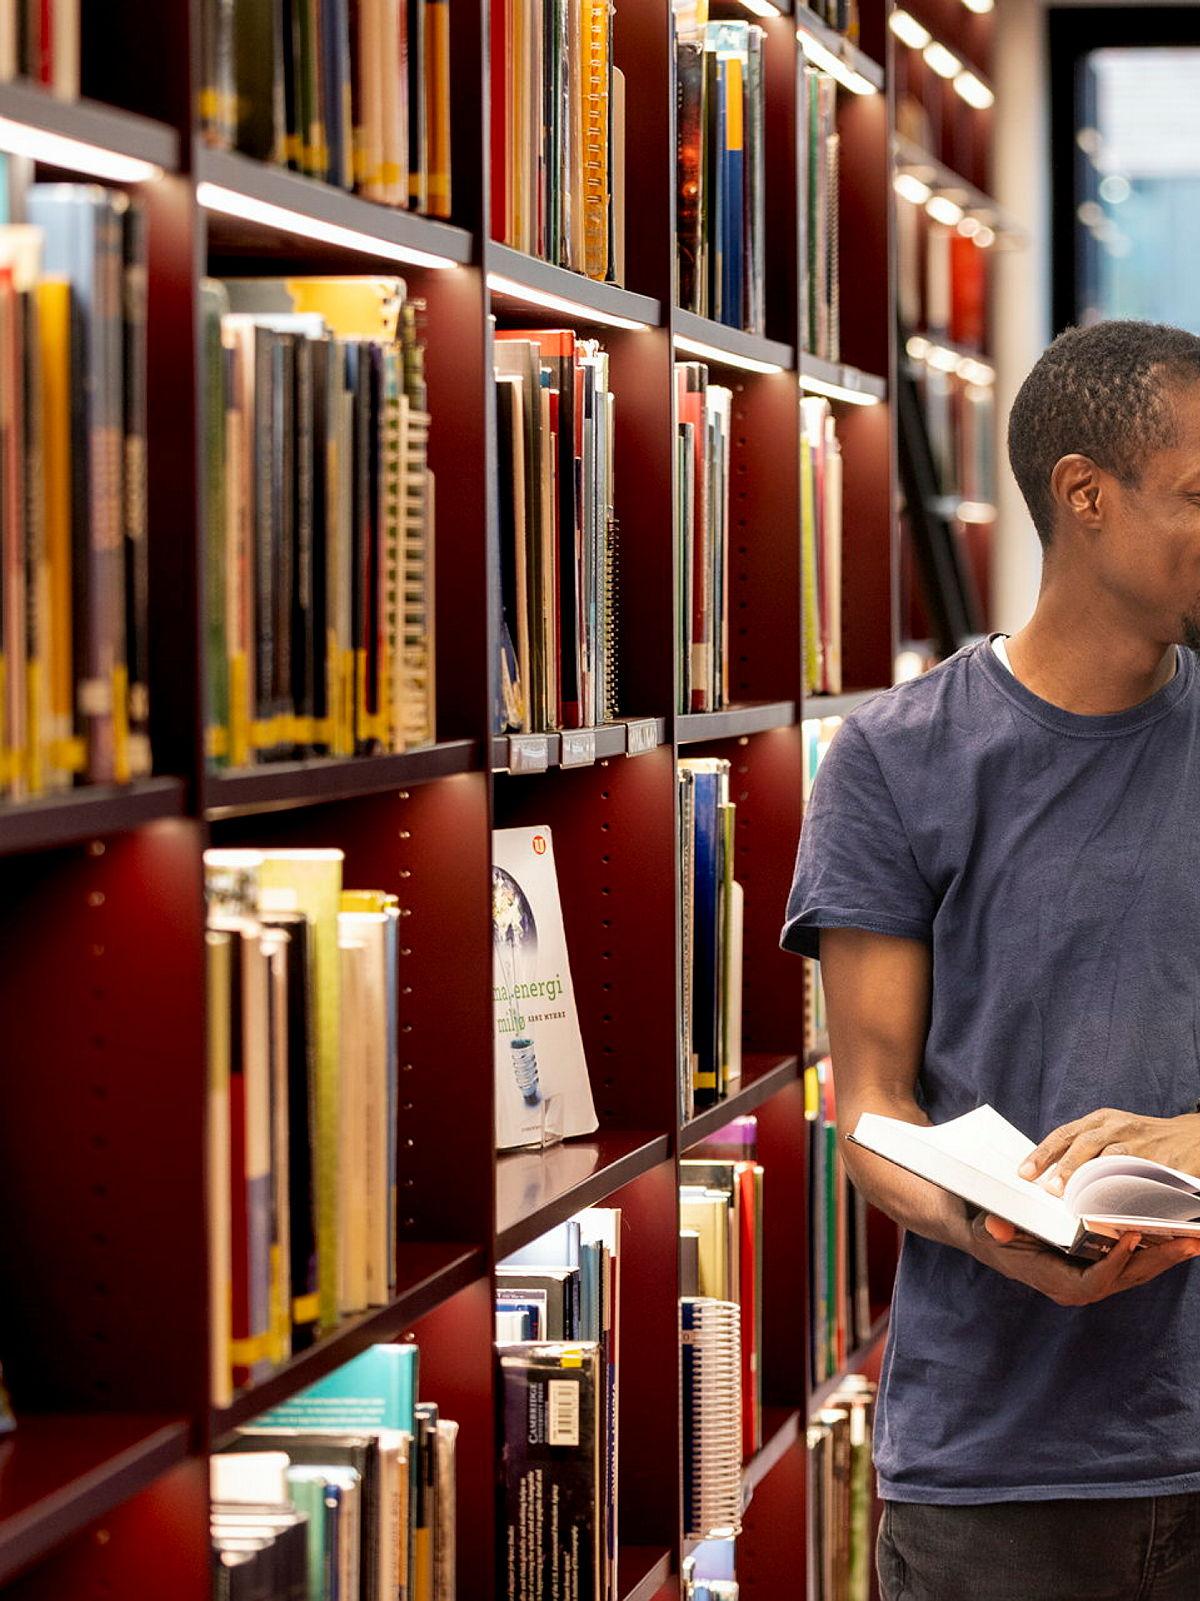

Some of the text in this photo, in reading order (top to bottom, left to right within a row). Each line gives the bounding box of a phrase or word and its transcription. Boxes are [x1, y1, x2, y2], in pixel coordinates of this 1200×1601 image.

[514, 973, 563, 1001] energi
[497, 1009, 526, 1035] miljø
[528, 1382, 538, 1444] CAMBRIDGE
